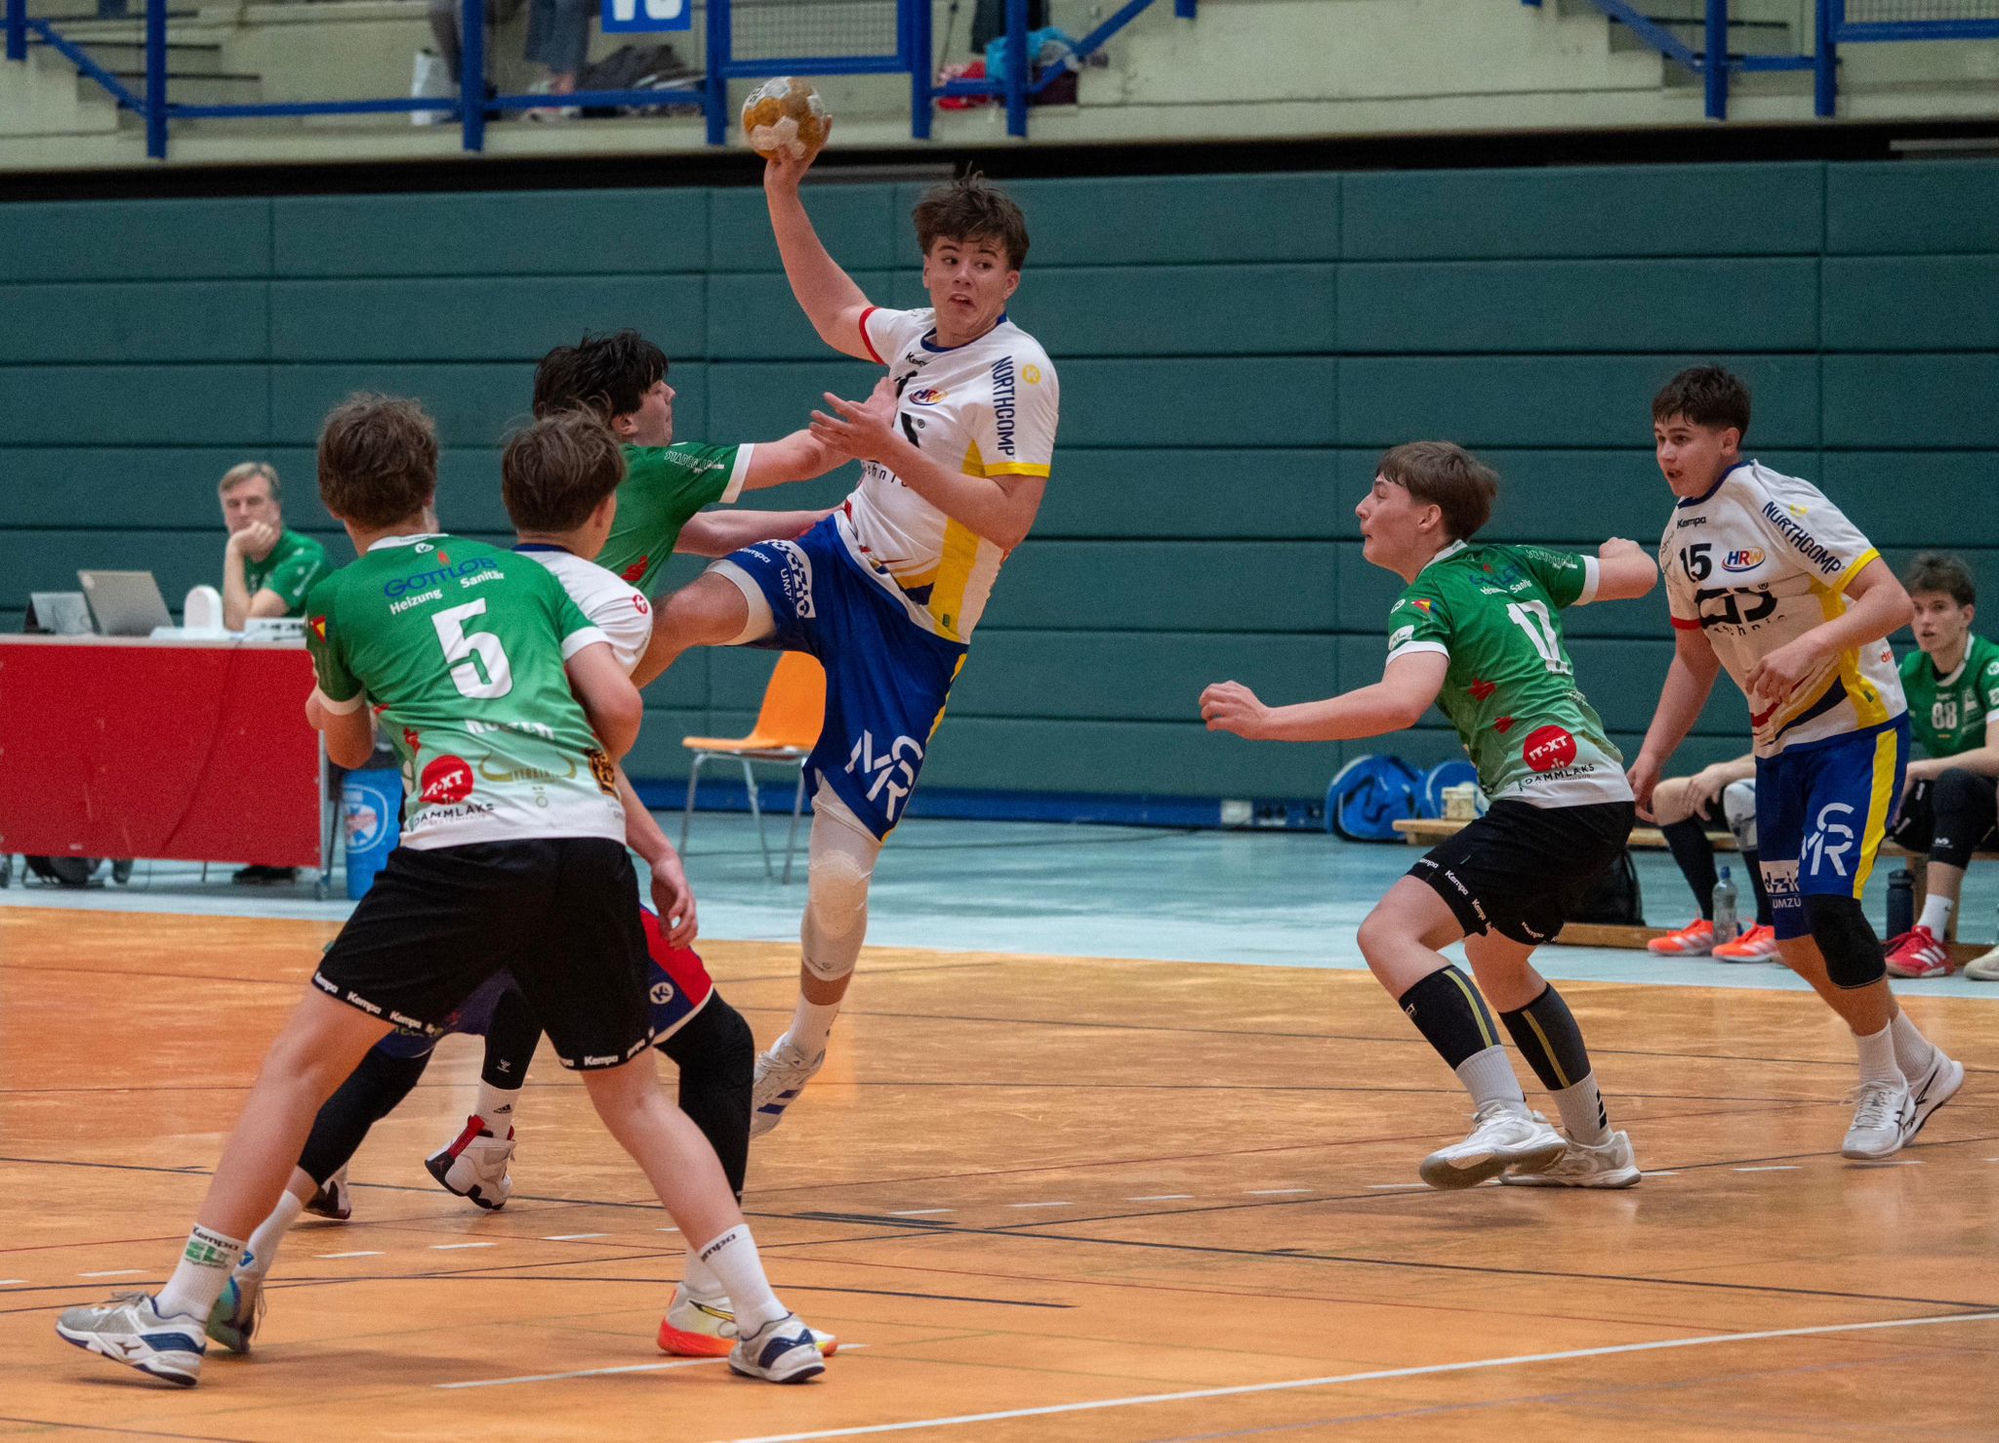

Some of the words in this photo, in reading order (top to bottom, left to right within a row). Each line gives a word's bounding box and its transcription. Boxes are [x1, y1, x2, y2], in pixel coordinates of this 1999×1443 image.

[1677, 516, 1706, 529] Kempa
[384, 556, 498, 597] GOTTLOB
[1679, 542, 1713, 584] 15
[389, 588, 443, 615] Heizung
[431, 597, 513, 699] 5
[1528, 734, 1568, 761] IT-XT
[1445, 870, 1469, 896] Kempa
[347, 991, 382, 1015] Kempa
[389, 1011, 422, 1029] Kempa
[584, 1055, 619, 1067] Kempa
